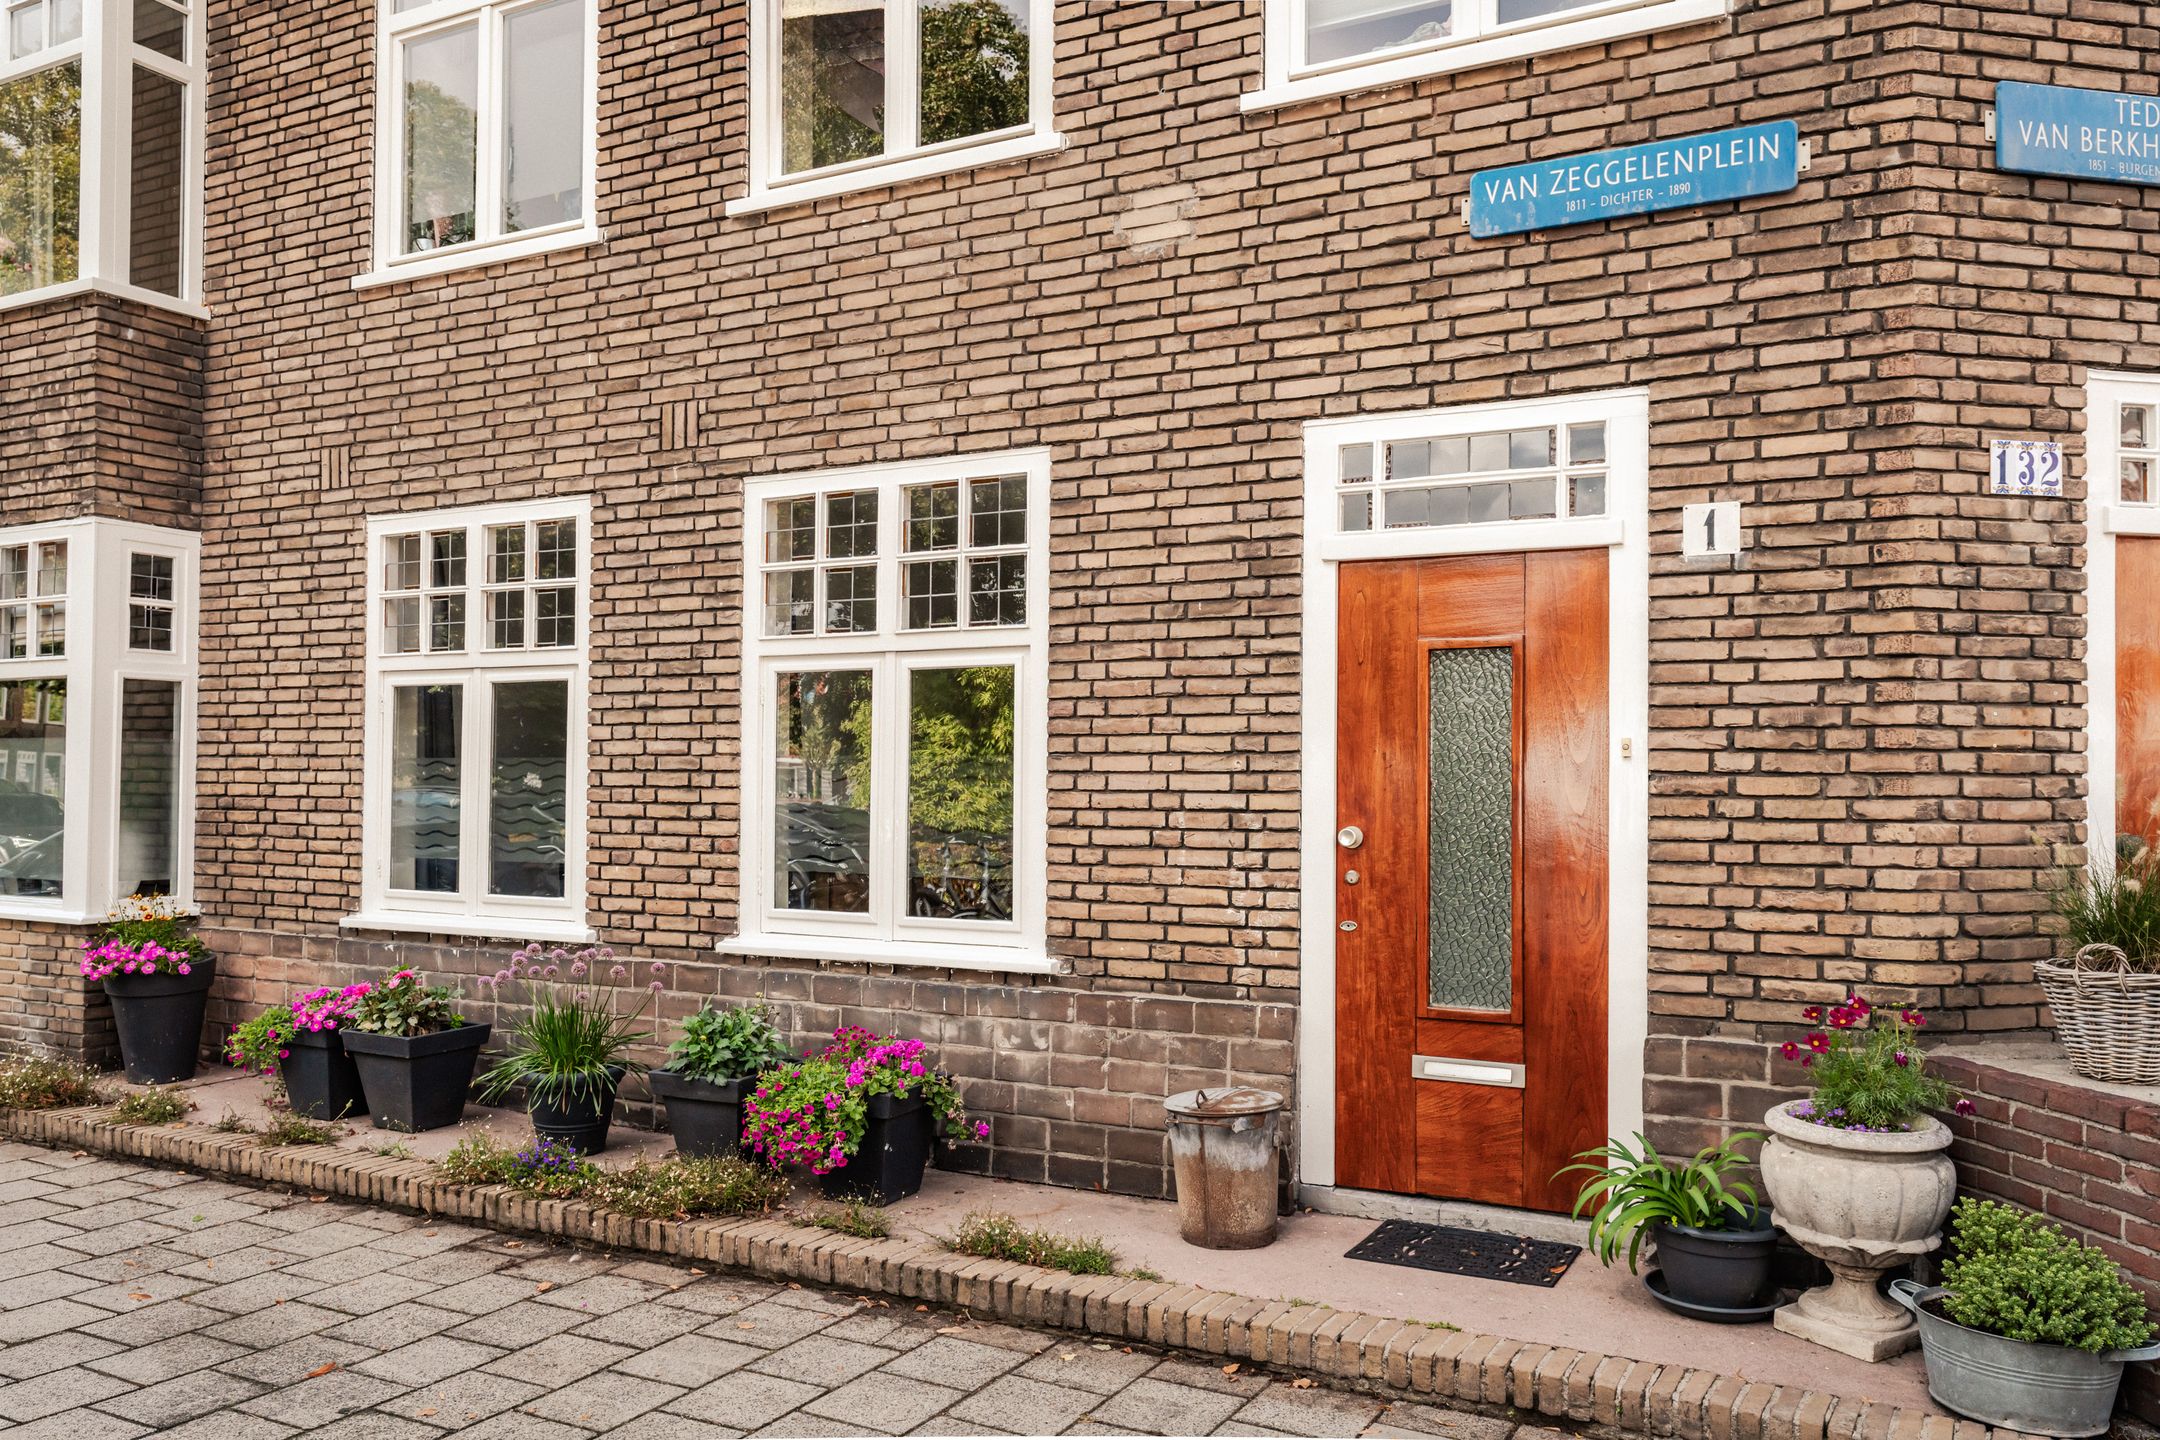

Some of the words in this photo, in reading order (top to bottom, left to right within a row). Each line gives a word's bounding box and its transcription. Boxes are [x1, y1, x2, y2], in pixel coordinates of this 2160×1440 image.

[2114, 98, 2160, 128] TED
[2018, 120, 2069, 150] VAN
[2081, 126, 2159, 159] BERKH
[1484, 174, 1537, 205] VAN
[1550, 133, 1780, 196] ZEGGELENPLEIN
[2088, 158, 2107, 172] 1851
[1565, 198, 1587, 213] 1811
[1600, 189, 1654, 208] DICHTER
[1668, 181, 1692, 197] 1890
[1995, 449, 2060, 488] 132
[1703, 508, 1717, 552] 1
